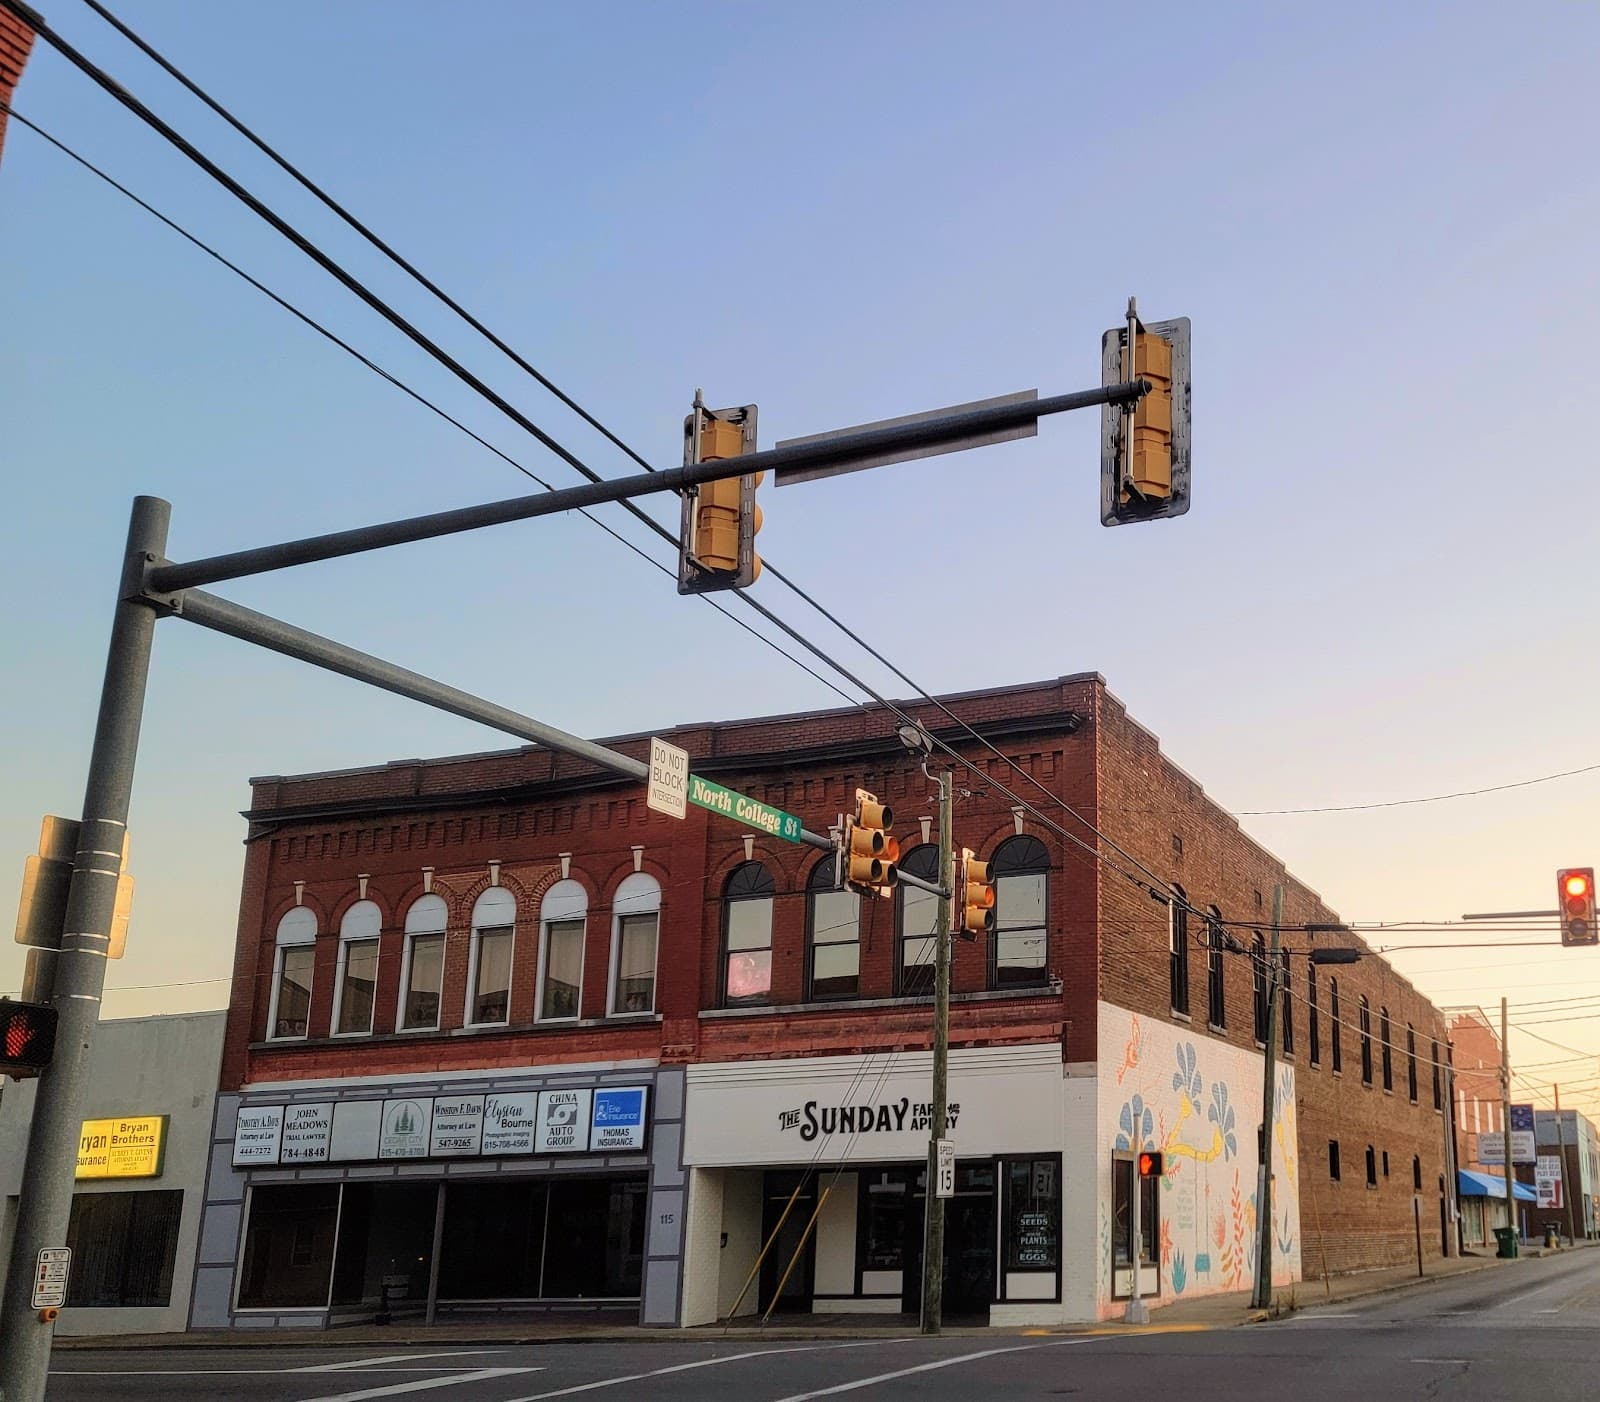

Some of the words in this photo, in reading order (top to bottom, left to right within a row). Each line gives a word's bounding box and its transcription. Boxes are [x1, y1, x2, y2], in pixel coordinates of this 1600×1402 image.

[654, 746, 666, 764] DO
[668, 754, 685, 771] NOT
[653, 767, 683, 792] BLOCK
[652, 790, 683, 808] INTERSECTION
[692, 780, 732, 813] North
[735, 798, 781, 832] College
[784, 818, 798, 838] St
[550, 1094, 577, 1104] CHINA
[294, 1109, 318, 1120] JOHN
[484, 1100, 522, 1124] Elysian
[913, 1104, 934, 1116] FAR
[502, 1118, 533, 1128] Bourne
[778, 1109, 800, 1131] THE
[800, 1097, 909, 1142] SUNDAY
[910, 1115, 958, 1131] APIRY
[120, 1123, 148, 1134] Bryan
[286, 1120, 328, 1130] MEADOWS
[548, 1126, 573, 1136] AUTO
[602, 1128, 630, 1136] THOMAS
[82, 1136, 107, 1152] ryan
[112, 1134, 154, 1144] Brothers
[546, 1136, 576, 1146] GROUP
[598, 1138, 634, 1146] INSURANCE
[282, 1148, 325, 1158] 784-4848
[940, 1146, 952, 1155] SPEED
[76, 1156, 107, 1166] surance
[941, 1170, 951, 1190] 15
[661, 1214, 674, 1224] 115
[1020, 1236, 1048, 1245] PLANTS
